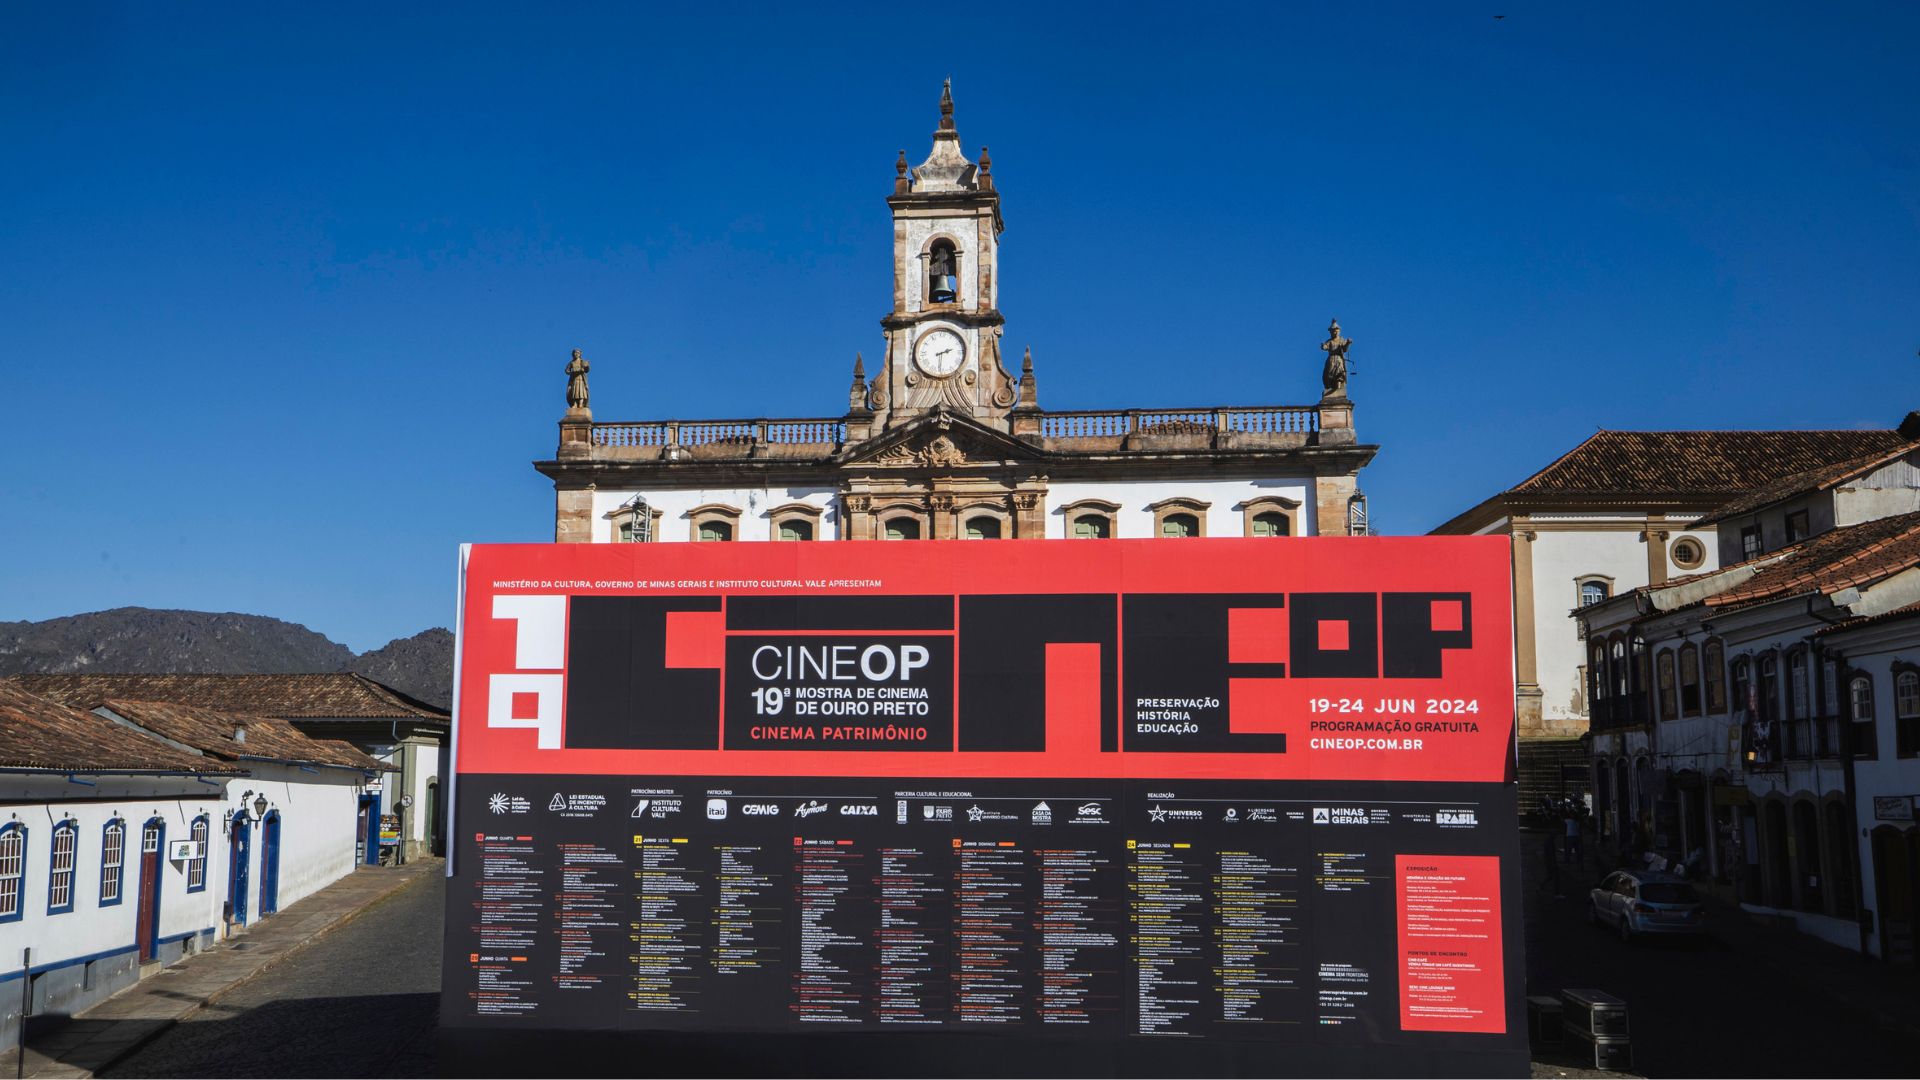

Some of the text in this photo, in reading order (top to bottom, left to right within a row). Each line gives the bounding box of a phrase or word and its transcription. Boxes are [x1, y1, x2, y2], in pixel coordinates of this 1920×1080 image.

[493, 580, 539, 588] MINISTÉRIO
[554, 580, 593, 589] CULTURA,
[752, 644, 930, 681] CINEOP
[796, 688, 852, 698] MOSTRA
[857, 688, 875, 698] DE
[878, 688, 928, 699] CINEMA
[796, 701, 929, 715] DE OURO PRETO
[1137, 697, 1219, 710] PRESERVAÇÃO
[1310, 698, 1478, 714] 19-24 JUN 2024
[1137, 709, 1190, 720] HISTÓRIA
[751, 724, 927, 740] CINEMA PATRIMÔNIO
[1137, 722, 1198, 735] EDUCAÇÃO
[1310, 720, 1479, 734] PROGRAMAÇÃO GRATUITA
[1310, 738, 1423, 750] CINEOP.COM.BR
[742, 804, 780, 816] CEMIG
[840, 806, 878, 816] CAIXA
[1331, 808, 1364, 816] MINAS
[1331, 816, 1369, 824] GERAIS
[1436, 813, 1478, 824] BRASIL
